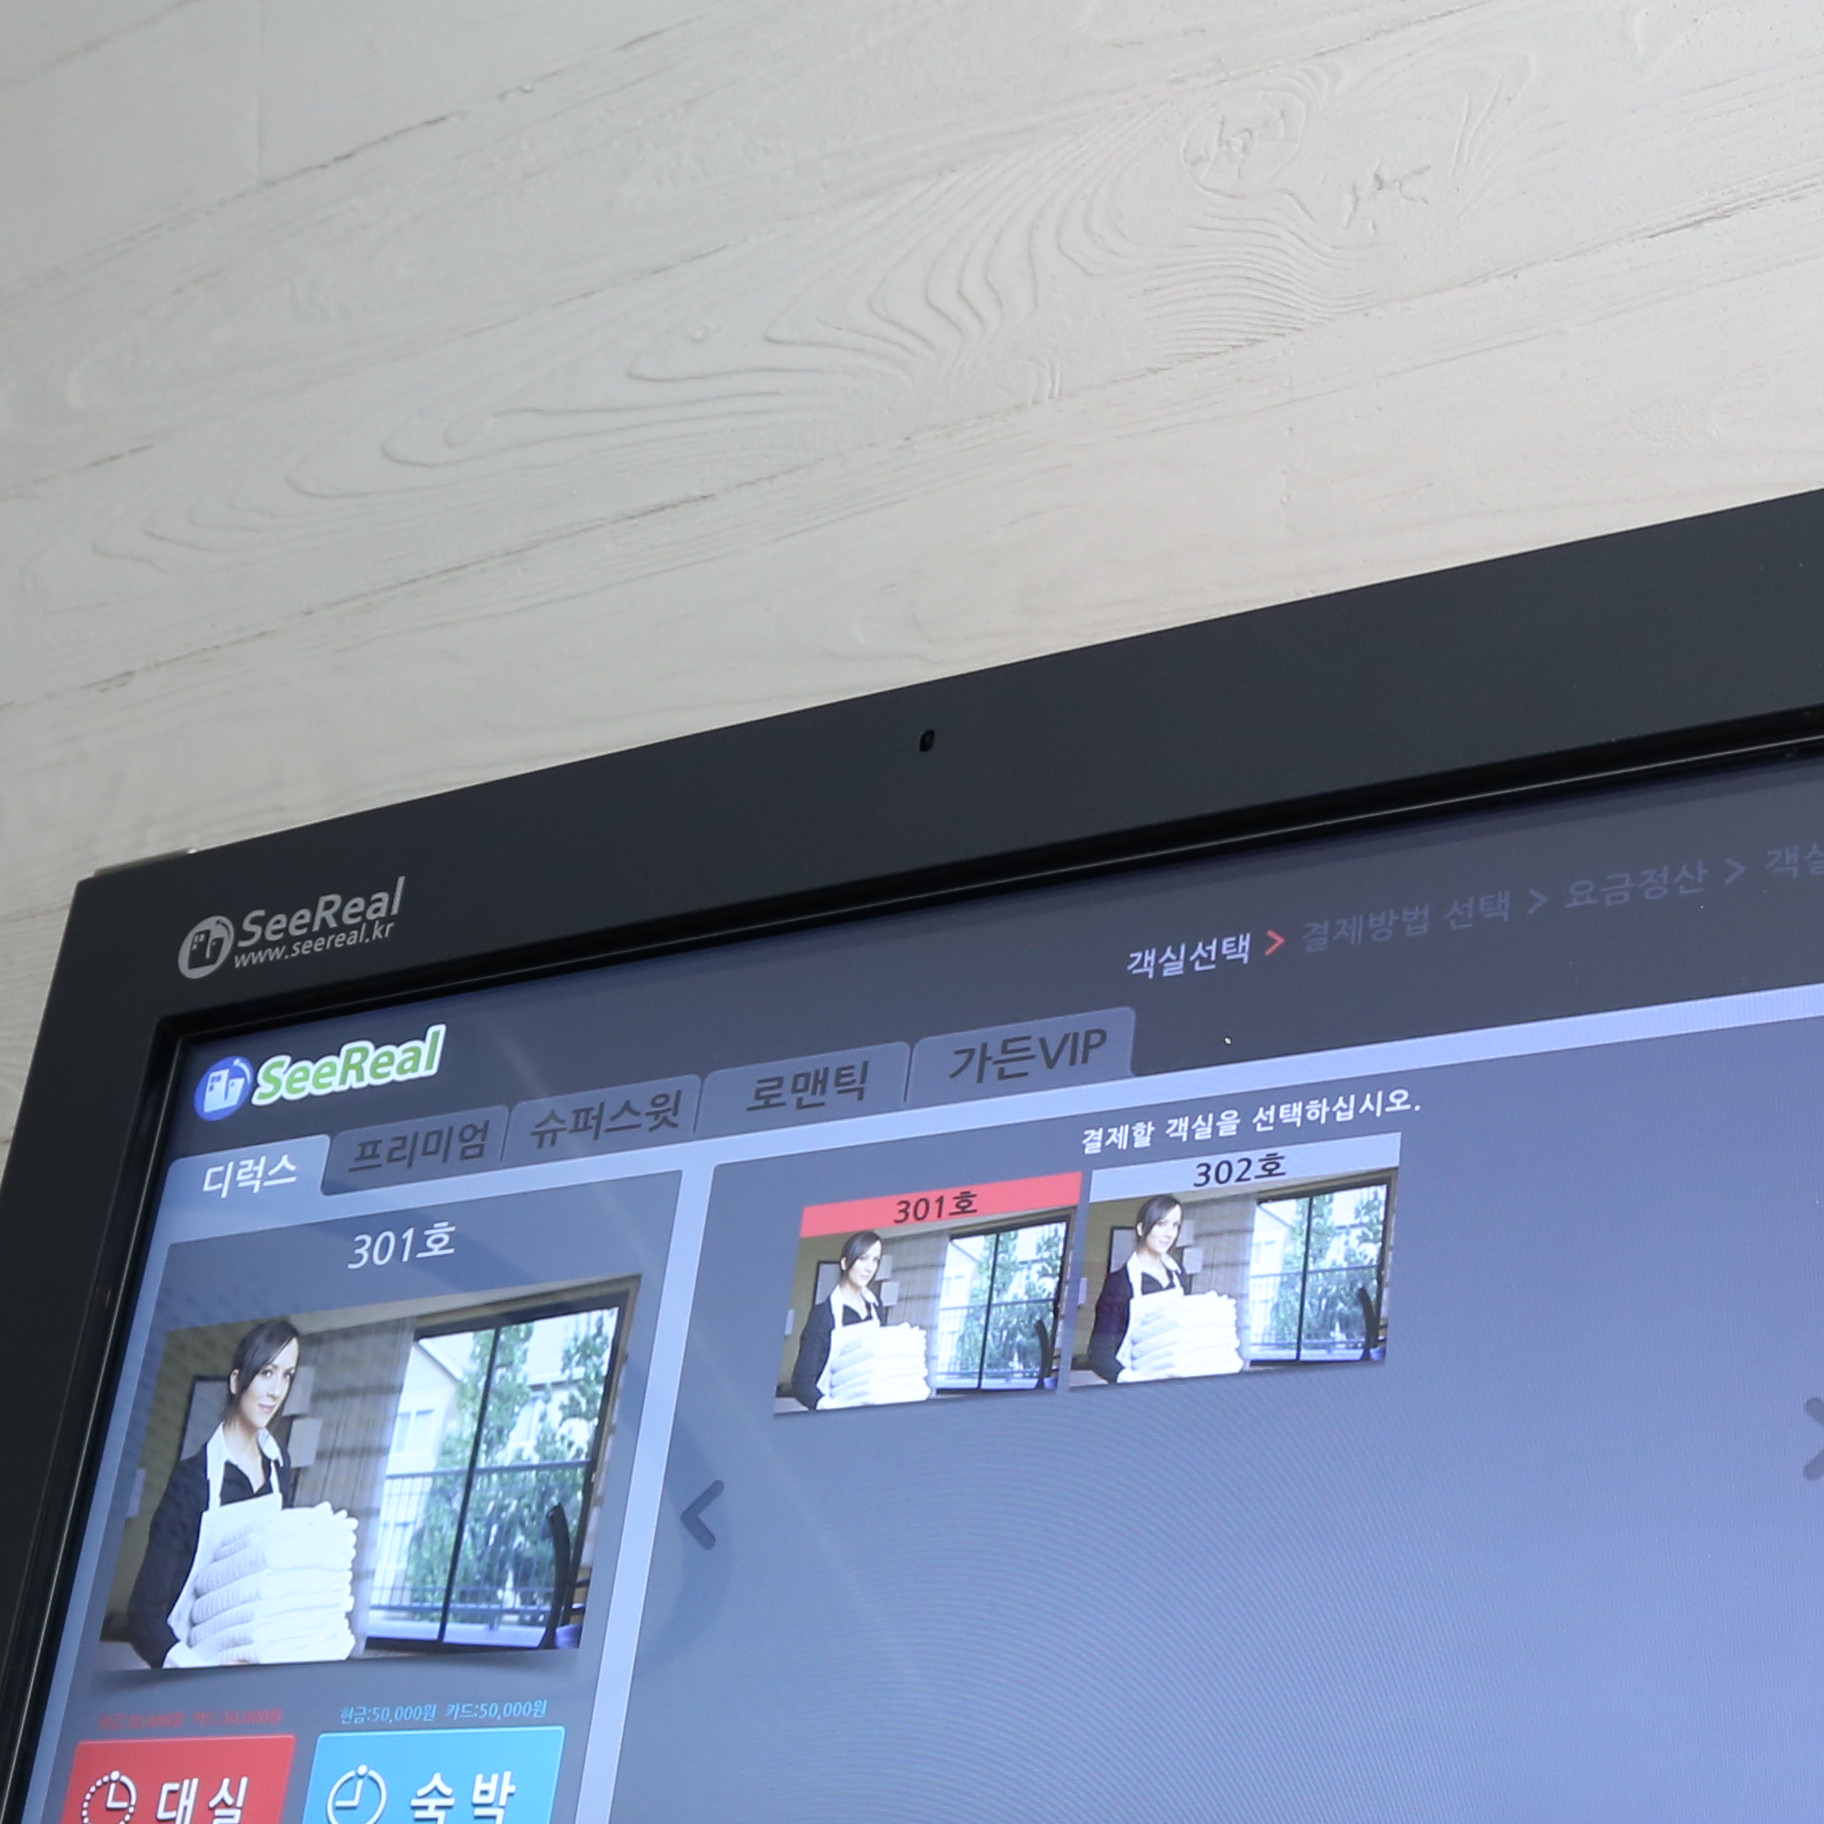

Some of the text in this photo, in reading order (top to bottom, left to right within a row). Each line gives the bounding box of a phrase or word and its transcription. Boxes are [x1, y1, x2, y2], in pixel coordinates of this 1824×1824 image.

[237, 875, 406, 948] SeeReal
[1564, 860, 1709, 908] 요금정산
[233, 920, 395, 969] www.seereal.kr
[1301, 889, 1512, 954] 결제방법 선택
[1127, 932, 1252, 979] 객실선택
[252, 1024, 446, 1106] SeeReal
[948, 1028, 1108, 1086] 가든VIP
[745, 1059, 870, 1114] 로맨틱
[347, 1119, 490, 1174] 프리미엄
[529, 1090, 682, 1149] 슈퍼스윗
[1080, 1088, 1422, 1155] 결제할 객실을 선택하십시오.
[201, 1152, 298, 1199] 디럭스
[1192, 1152, 1287, 1188] 302호
[893, 1190, 979, 1224] 301호
[346, 1221, 457, 1270] 301호
